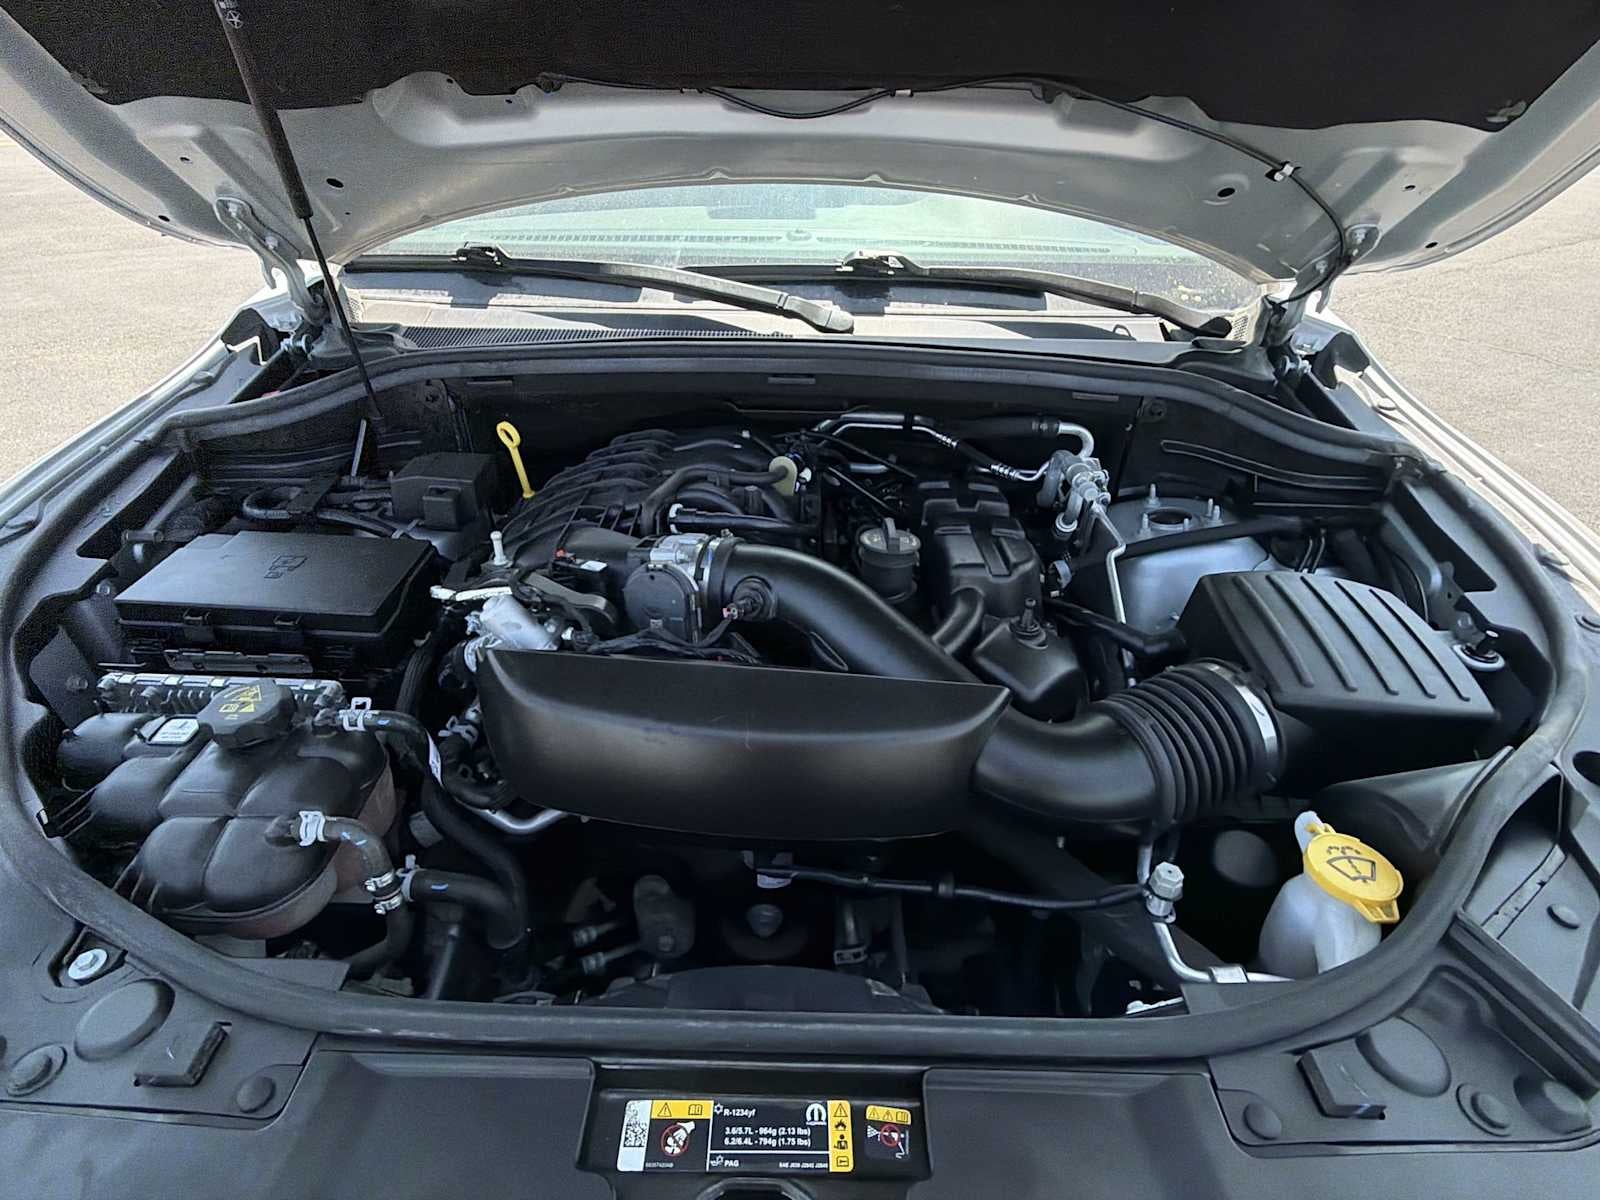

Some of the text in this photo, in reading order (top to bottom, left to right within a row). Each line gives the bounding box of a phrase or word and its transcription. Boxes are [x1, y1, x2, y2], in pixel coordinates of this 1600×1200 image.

[723, 1108, 756, 1118] R-1234yf
[725, 1126, 754, 1135] 3.6/5.7L
[778, 1126, 796, 1136] (2.13
[796, 1126, 811, 1137] lbs)
[724, 1137, 753, 1145] 6.2/6.4L
[758, 1137, 777, 1147] 794g
[778, 1137, 796, 1147] (1.75
[796, 1137, 811, 1147] lbs)
